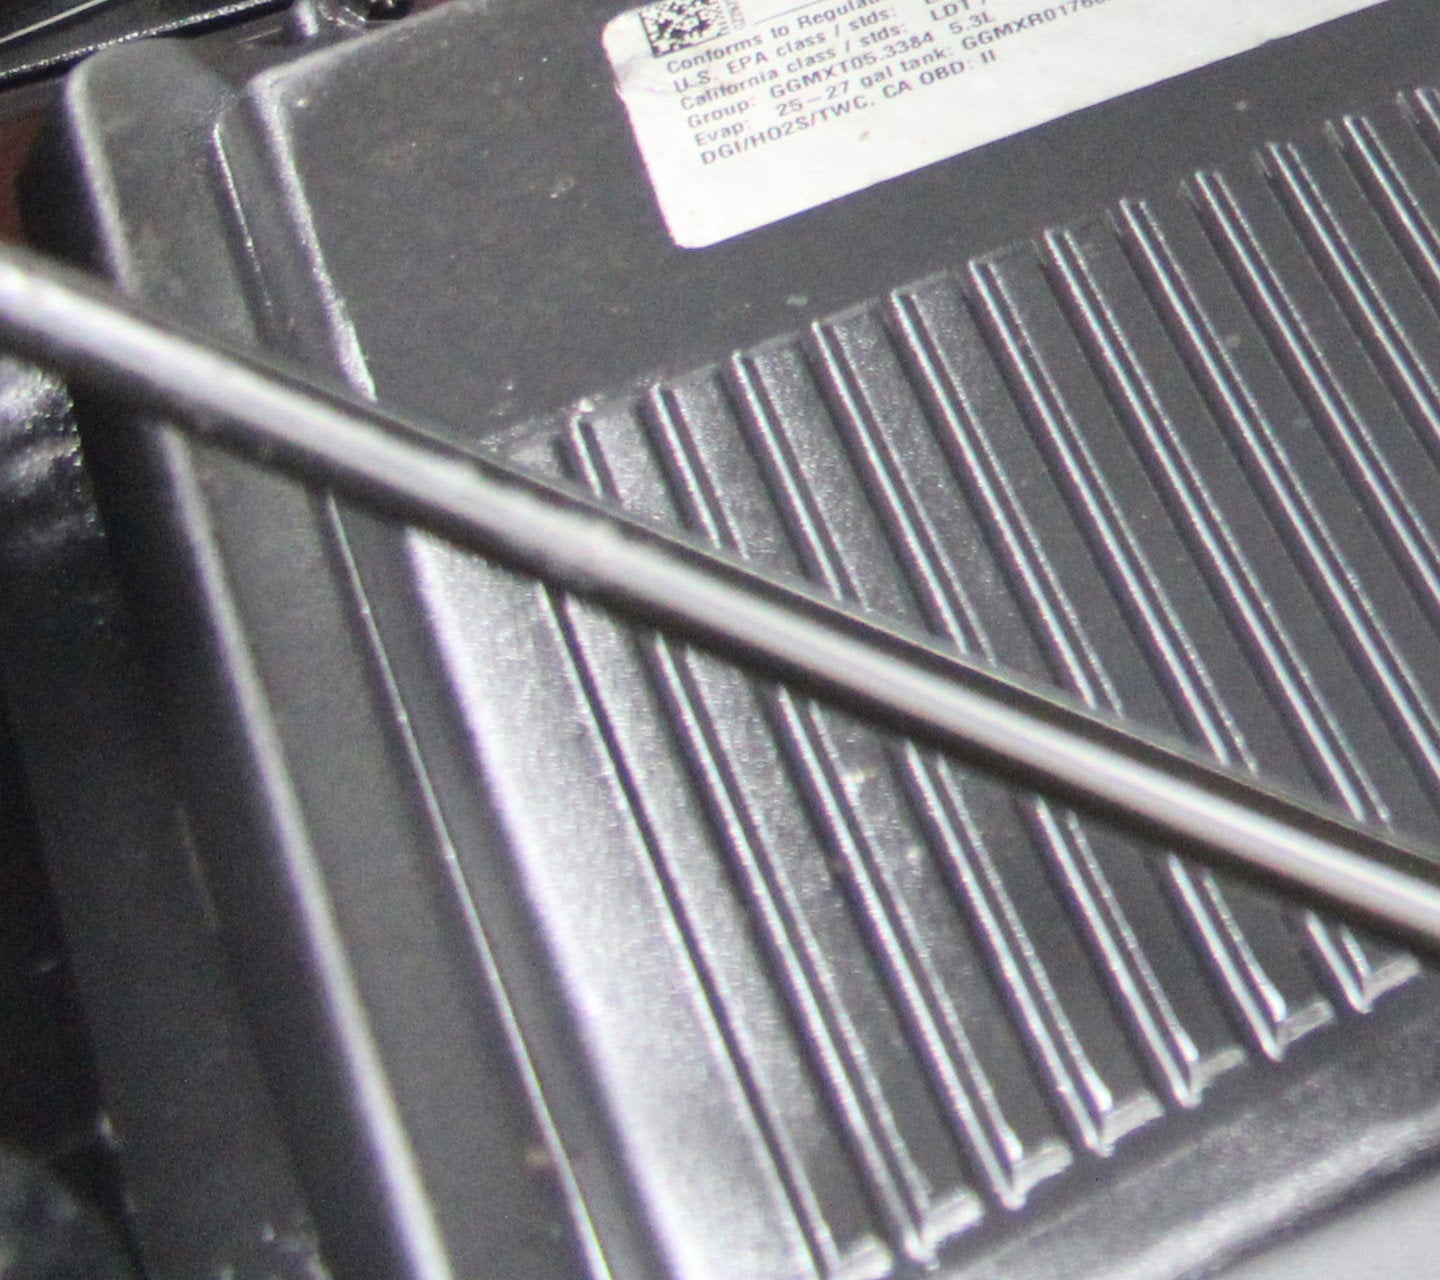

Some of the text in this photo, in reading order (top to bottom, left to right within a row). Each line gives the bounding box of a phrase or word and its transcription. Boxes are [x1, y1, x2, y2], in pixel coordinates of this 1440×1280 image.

[666, 35, 763, 74] Conforms
[770, 26, 790, 39] to
[680, 69, 779, 110] California
[787, 48, 837, 73] class
[859, 24, 907, 47] stds:
[687, 10, 996, 128] Group: GGMXT05.3384 5.3L
[726, 51, 768, 75] EPA
[776, 32, 826, 57] class
[848, 8, 896, 31] stds:
[882, 80, 913, 98] CA
[919, 61, 973, 85] OBD:
[980, 49, 996, 64] II
[694, 120, 750, 147] Evap:
[860, 66, 893, 89] gal
[900, 47, 953, 72] tank:
